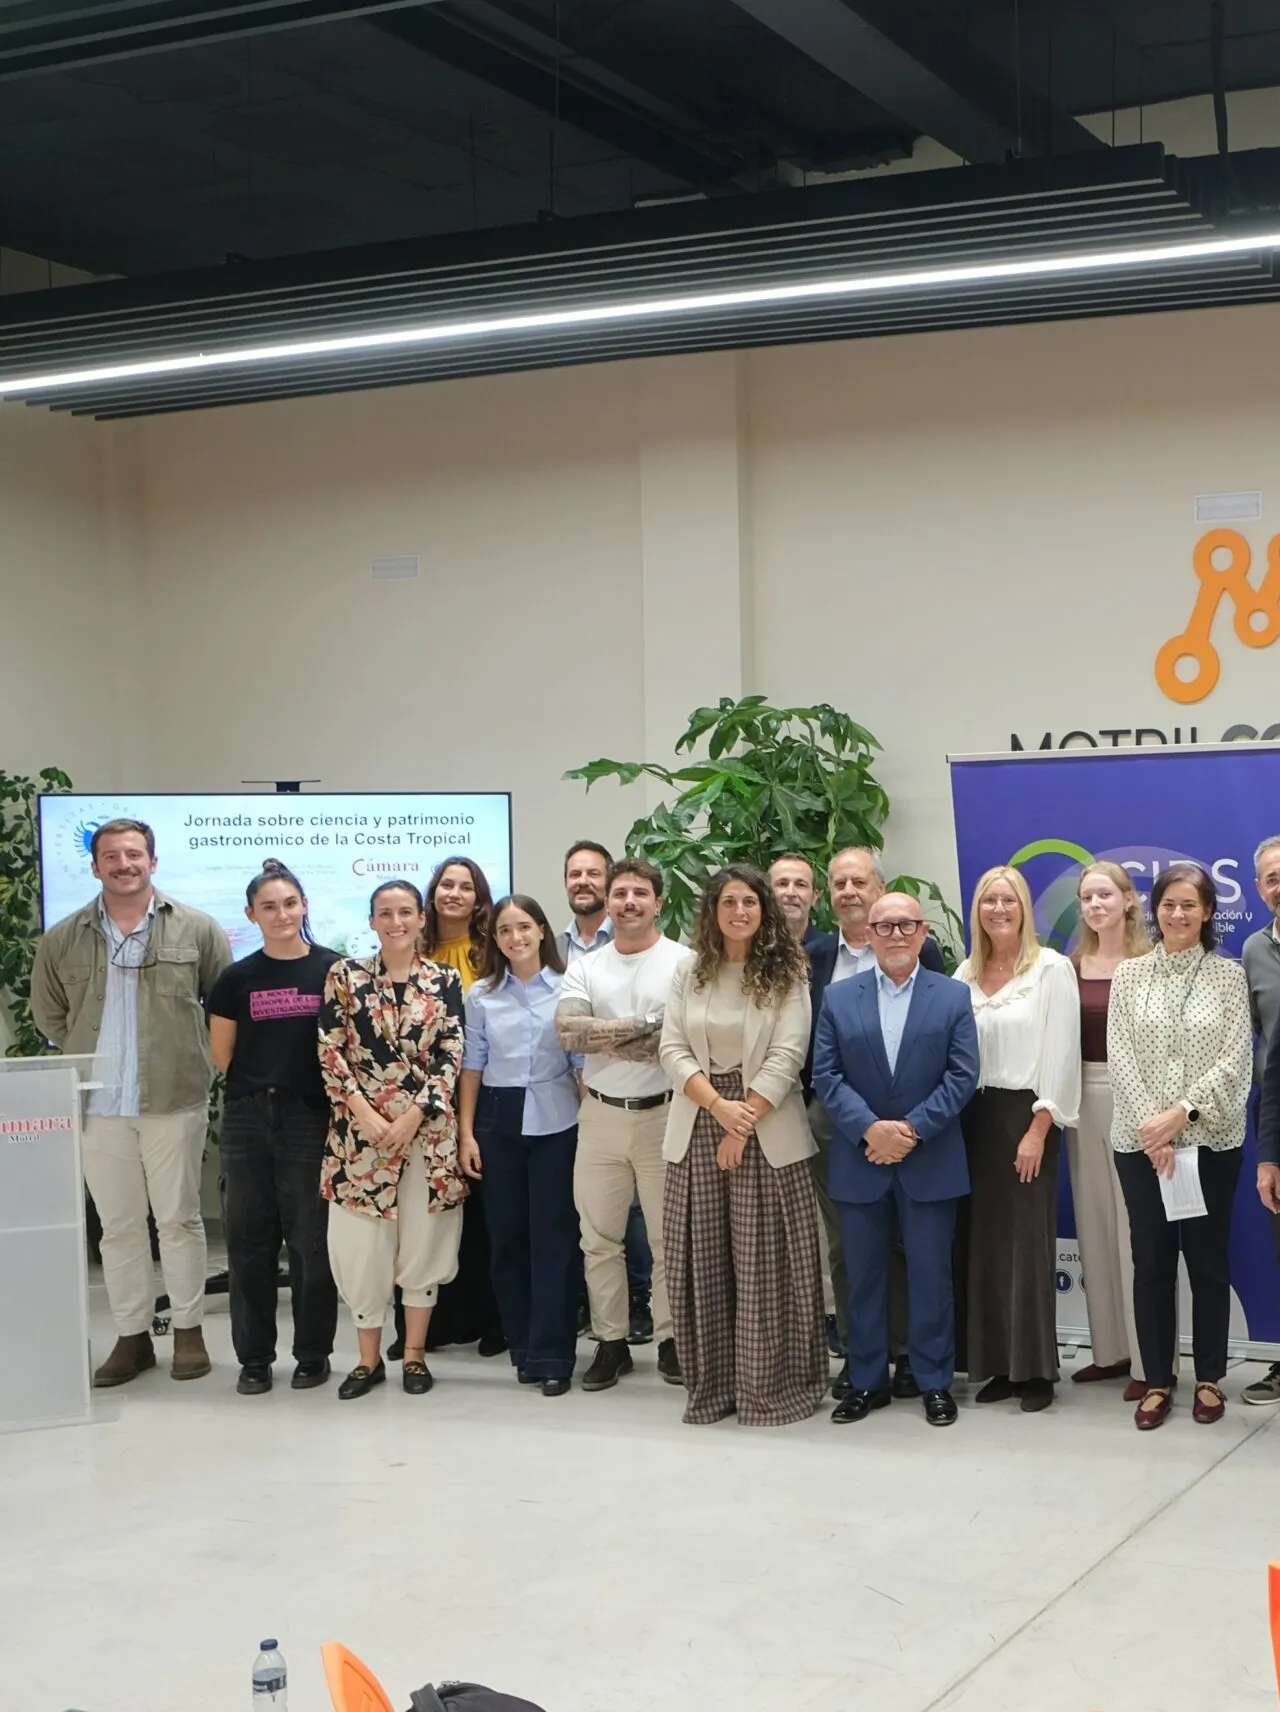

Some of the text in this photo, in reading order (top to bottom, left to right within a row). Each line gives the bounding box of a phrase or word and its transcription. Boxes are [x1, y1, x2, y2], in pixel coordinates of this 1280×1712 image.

[184, 813, 475, 830] Jornada sobre ciencia y patrimonio
[188, 831, 471, 849] gastronómico de la Costa Tropical
[352, 857, 419, 876] Cámara
[0, 1115, 72, 1133] ámara
